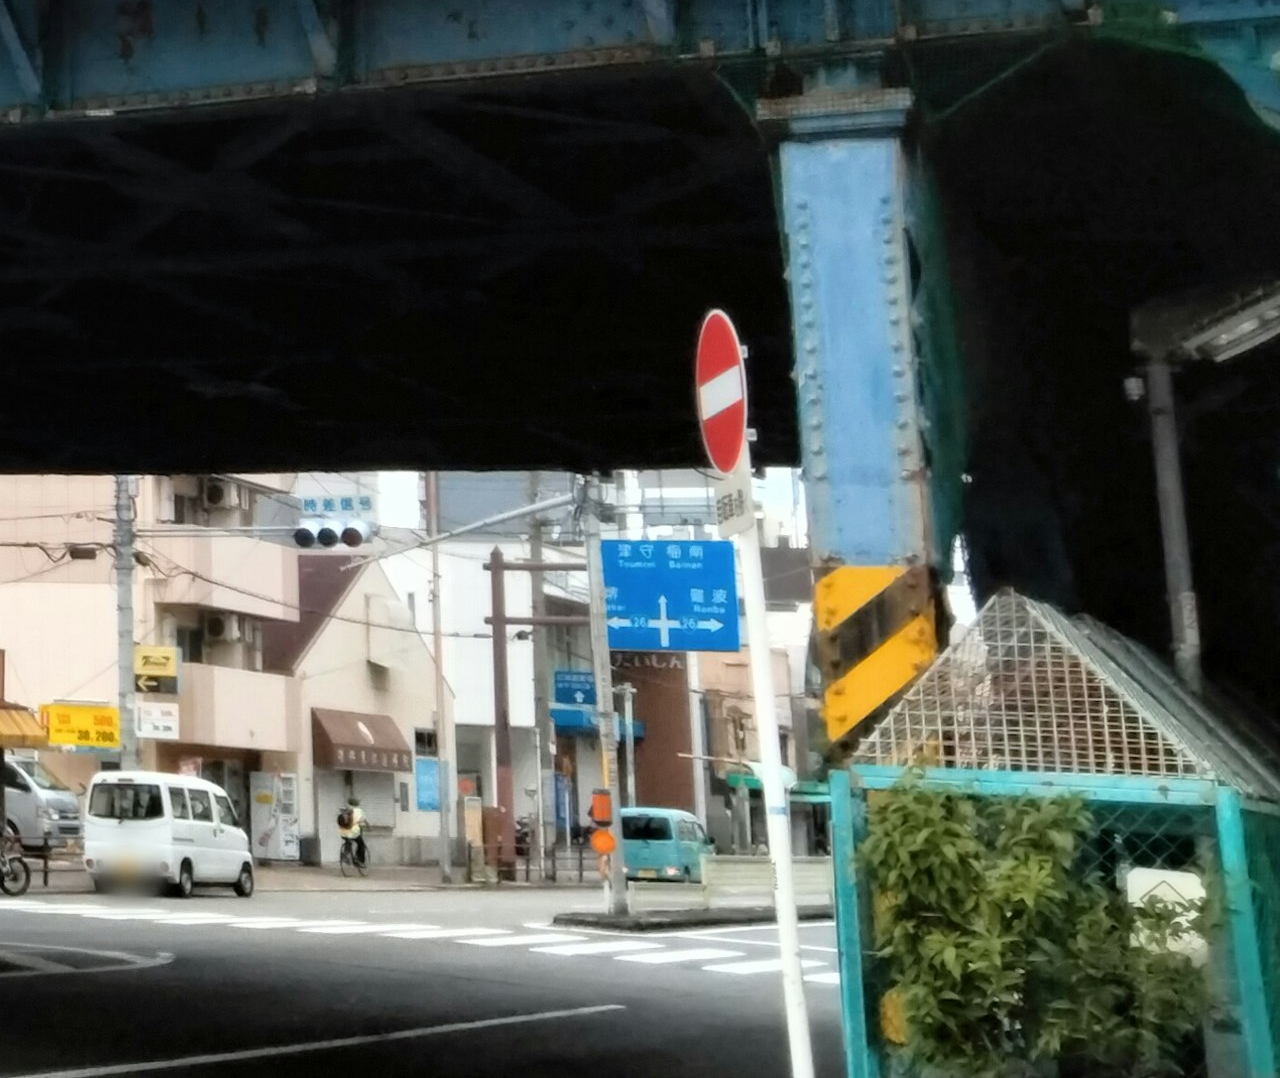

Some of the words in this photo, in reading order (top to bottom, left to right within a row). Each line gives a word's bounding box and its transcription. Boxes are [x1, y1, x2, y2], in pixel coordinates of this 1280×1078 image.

[303, 496, 372, 512] 時差信号
[618, 544, 654, 558] 津守
